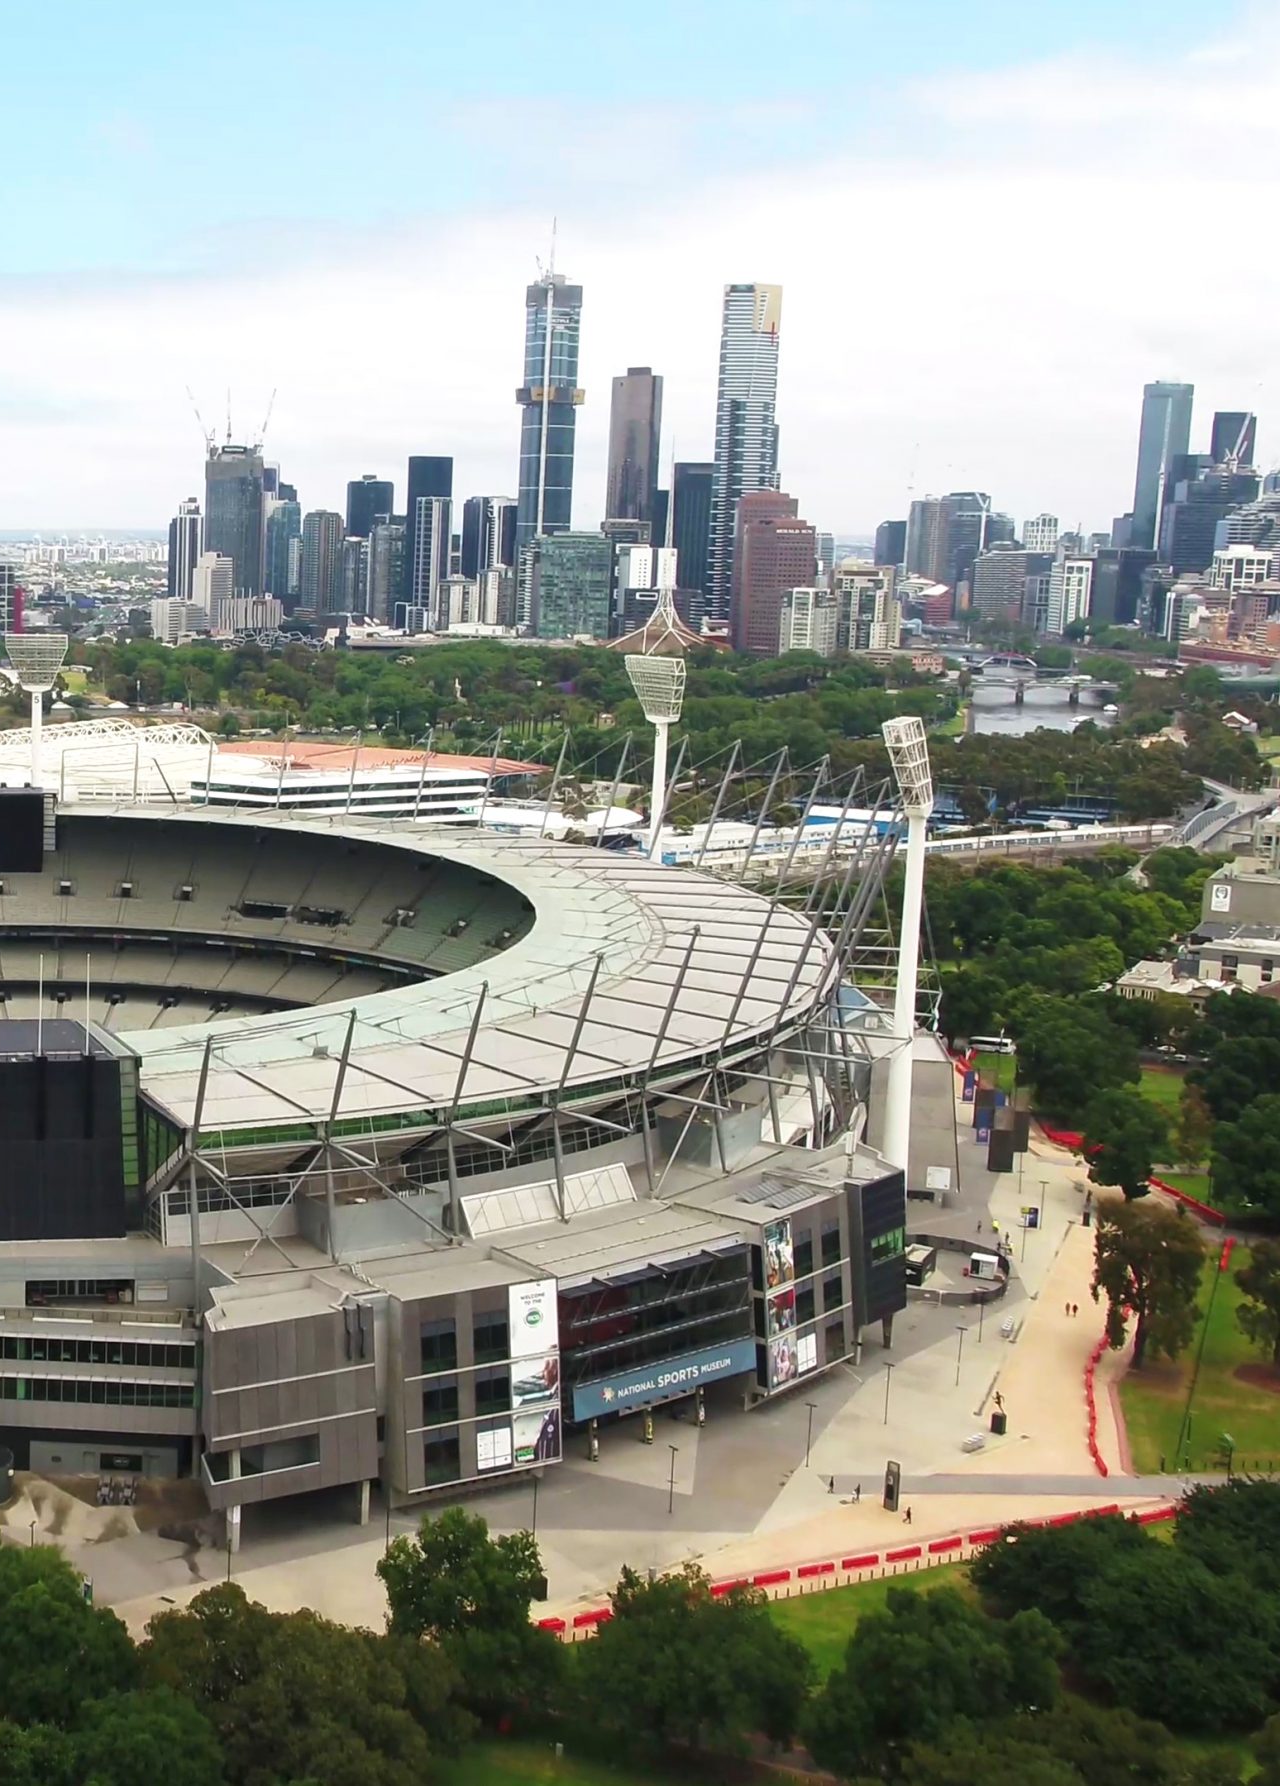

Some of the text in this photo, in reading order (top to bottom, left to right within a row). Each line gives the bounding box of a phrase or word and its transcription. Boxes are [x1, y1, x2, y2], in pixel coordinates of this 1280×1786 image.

[33, 695, 40, 704] 5
[520, 1291, 545, 1300] WELCOME
[617, 1358, 732, 1399] NATIONAL SPORTS MUSEUM
